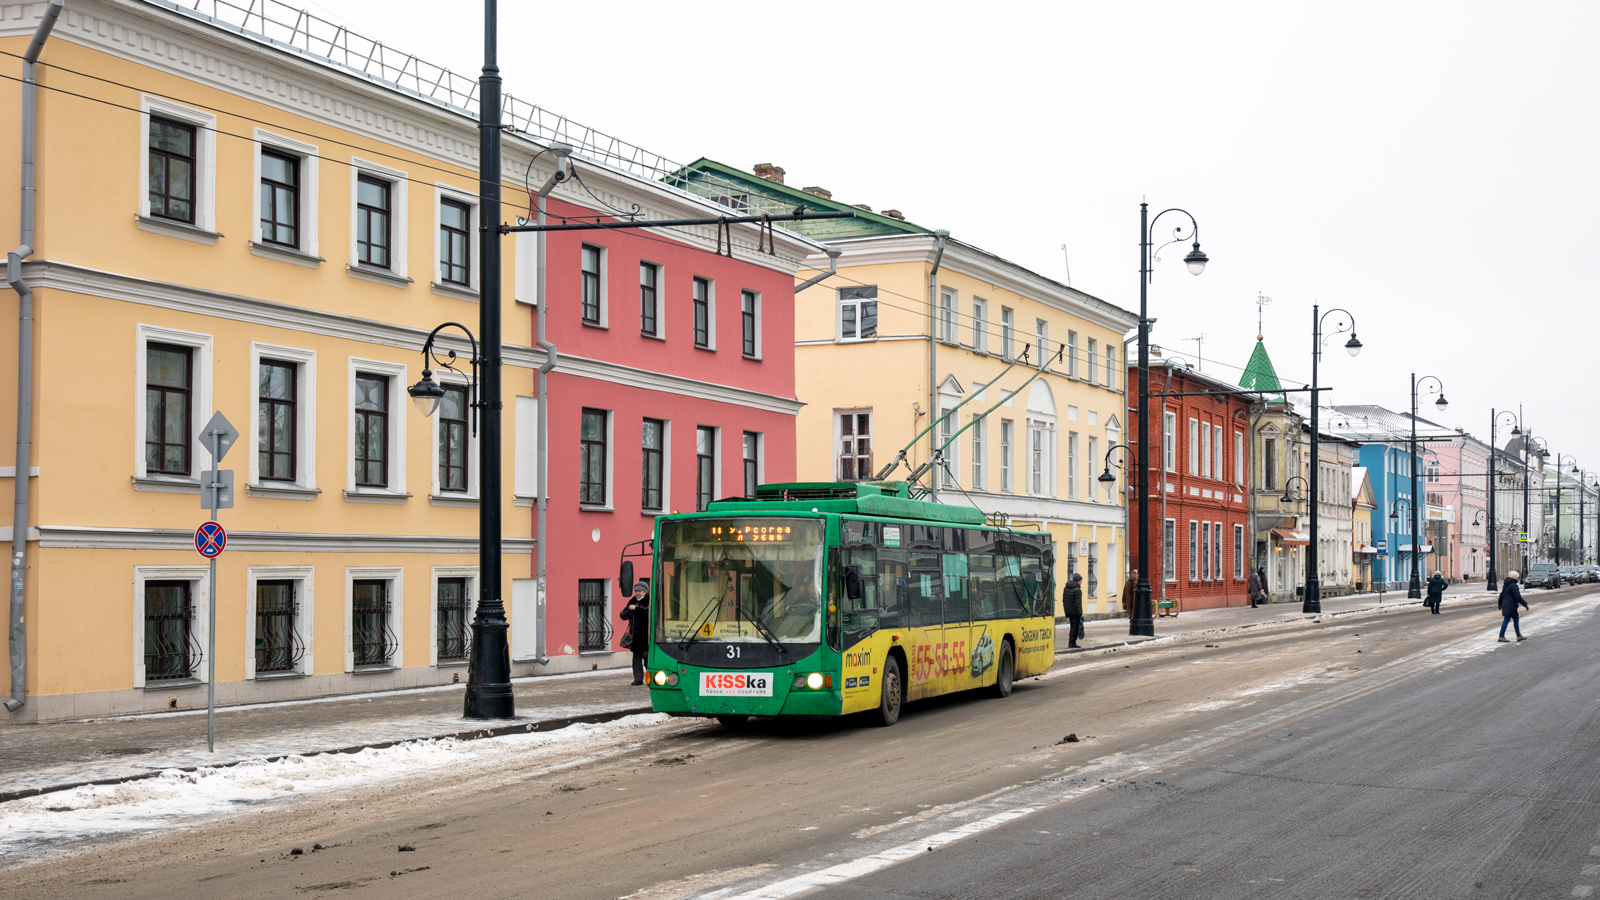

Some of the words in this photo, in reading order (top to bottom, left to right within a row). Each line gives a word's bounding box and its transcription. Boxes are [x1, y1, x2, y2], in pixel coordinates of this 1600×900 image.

[703, 624, 711, 636] 4
[726, 645, 740, 658] 31
[846, 647, 871, 668] maxim
